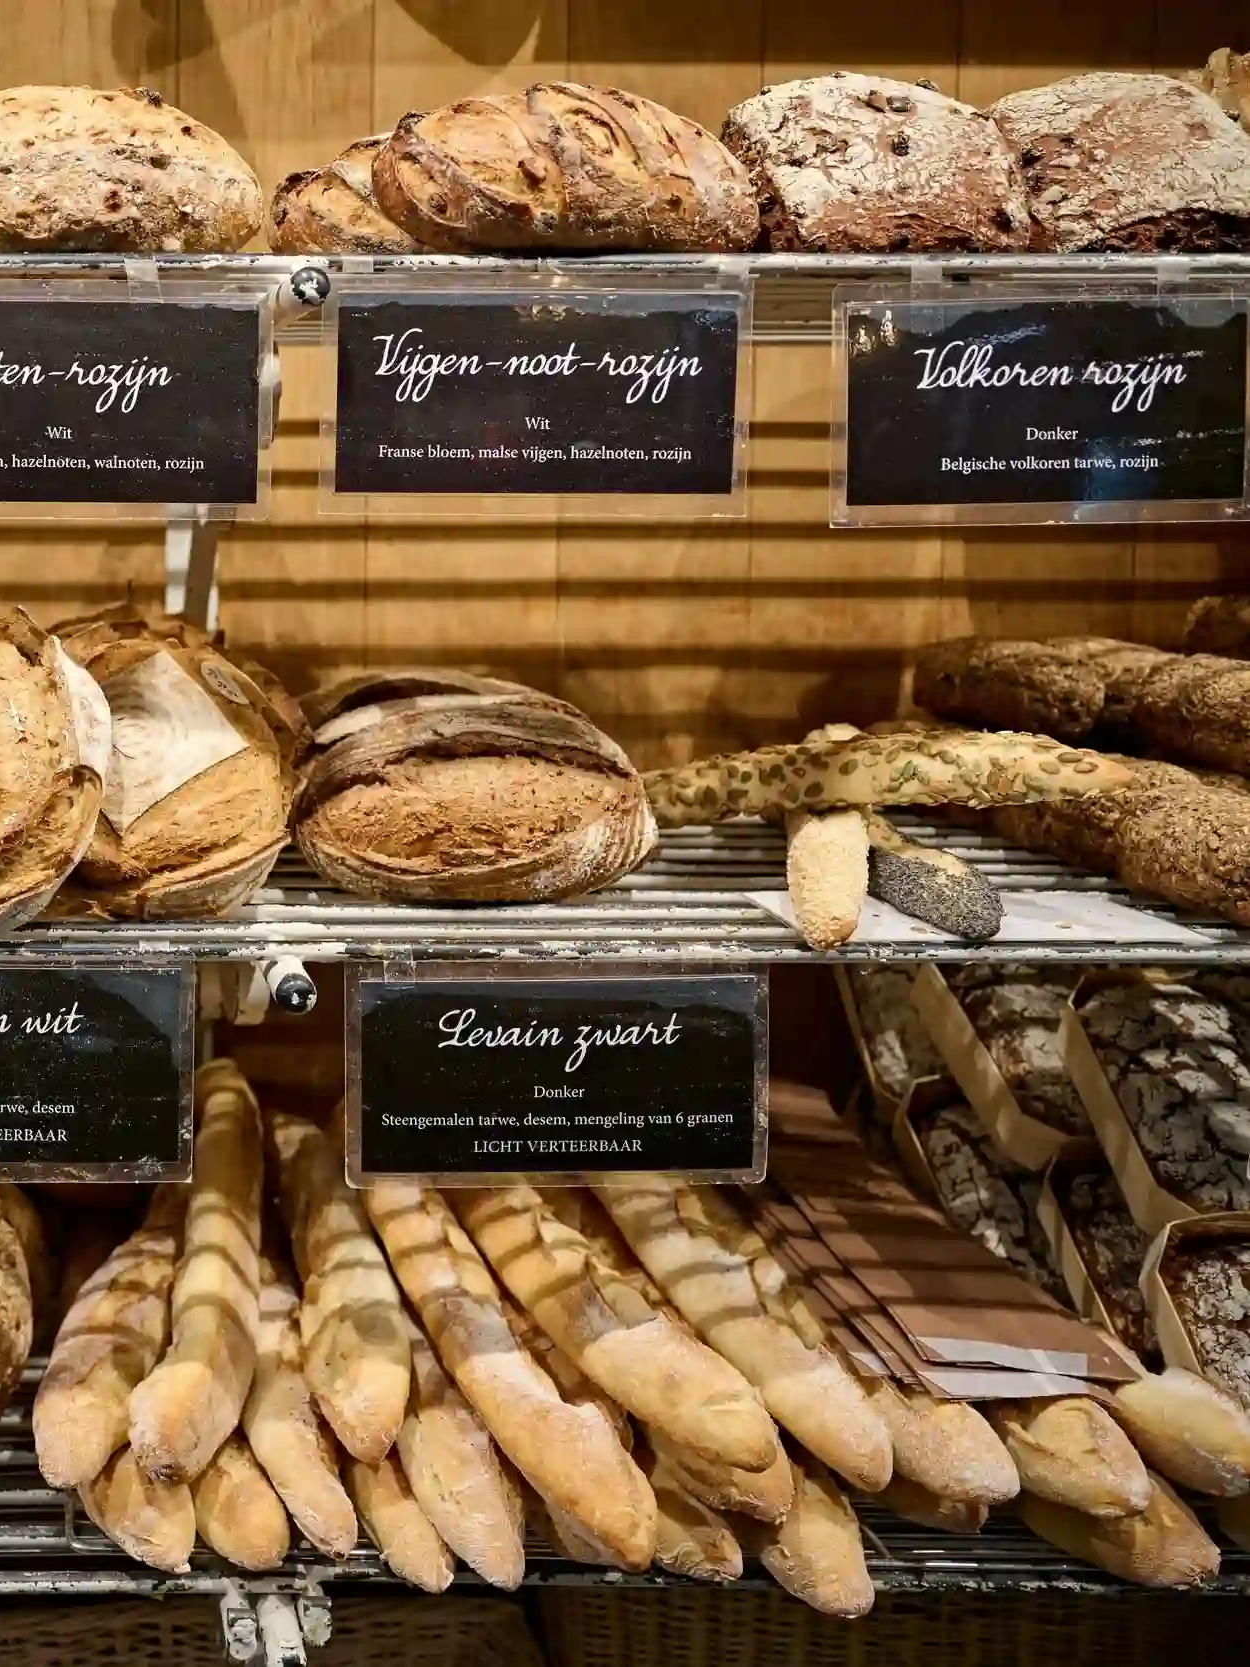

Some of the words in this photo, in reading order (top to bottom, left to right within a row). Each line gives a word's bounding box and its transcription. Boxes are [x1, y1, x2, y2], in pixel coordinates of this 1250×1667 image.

[373, 328, 702, 403] Vijgen-noot-rozijn
[914, 341, 1073, 389] Volkoren
[1081, 357, 1186, 413] rozijn
[525, 417, 551, 429] Wit
[47, 426, 72, 439] Wit
[1026, 427, 1078, 440] Donker
[379, 445, 424, 459] Franse
[428, 445, 475, 460] bloem,
[478, 445, 519, 459] malse
[522, 447, 566, 463] vijgen,
[570, 446, 648, 461] hazelnoten,
[652, 448, 691, 463] rozijn
[12, 455, 90, 469] hazelnoten,
[94, 456, 161, 470] walnoten,
[165, 458, 205, 473] rozijn
[941, 456, 1006, 474] Belgische
[1009, 455, 1070, 470] volkoren
[1074, 457, 1116, 470] tarwe,
[1120, 455, 1158, 471] rozijn
[21, 1001, 84, 1034] wit
[438, 1008, 564, 1048] Levain
[564, 1013, 682, 1072] zwart
[534, 1086, 585, 1098] Donker
[32, 1101, 75, 1115] desem
[381, 1113, 474, 1129] Steengemalen
[478, 1113, 520, 1128] tarwe,
[524, 1112, 571, 1127] desem,
[574, 1112, 644, 1128] mengeling
[648, 1114, 672, 1124] van
[676, 1112, 684, 1124] 6
[687, 1112, 733, 1126] granen
[474, 1140, 523, 1153] LICHT
[528, 1139, 642, 1152] VERTEERBAAR
